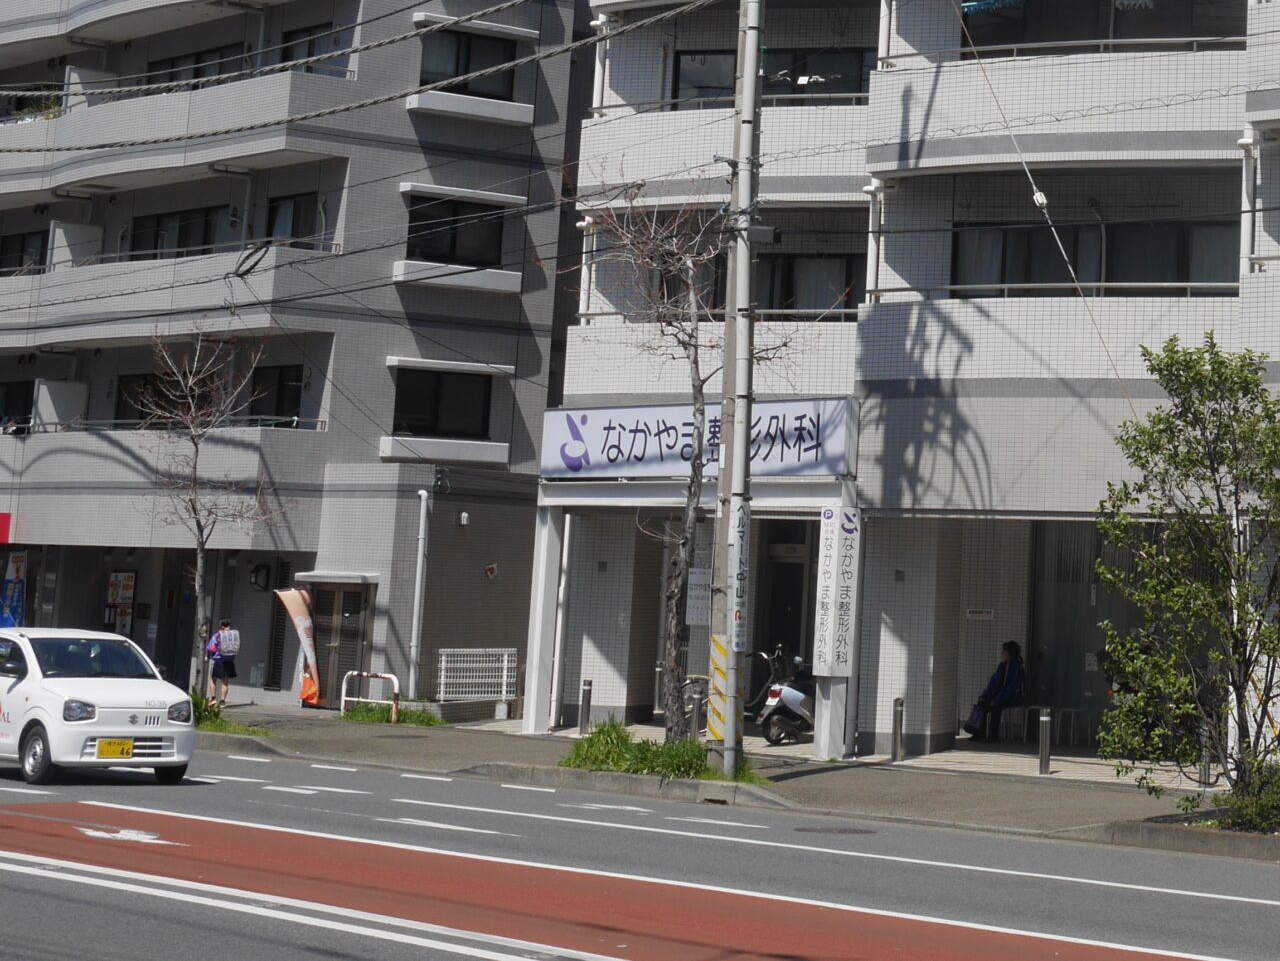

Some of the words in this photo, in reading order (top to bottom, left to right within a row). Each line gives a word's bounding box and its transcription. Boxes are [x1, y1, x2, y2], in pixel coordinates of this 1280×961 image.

[818, 536, 834, 667] なかやま整形外科
[835, 536, 855, 667] なかやま整形外科
